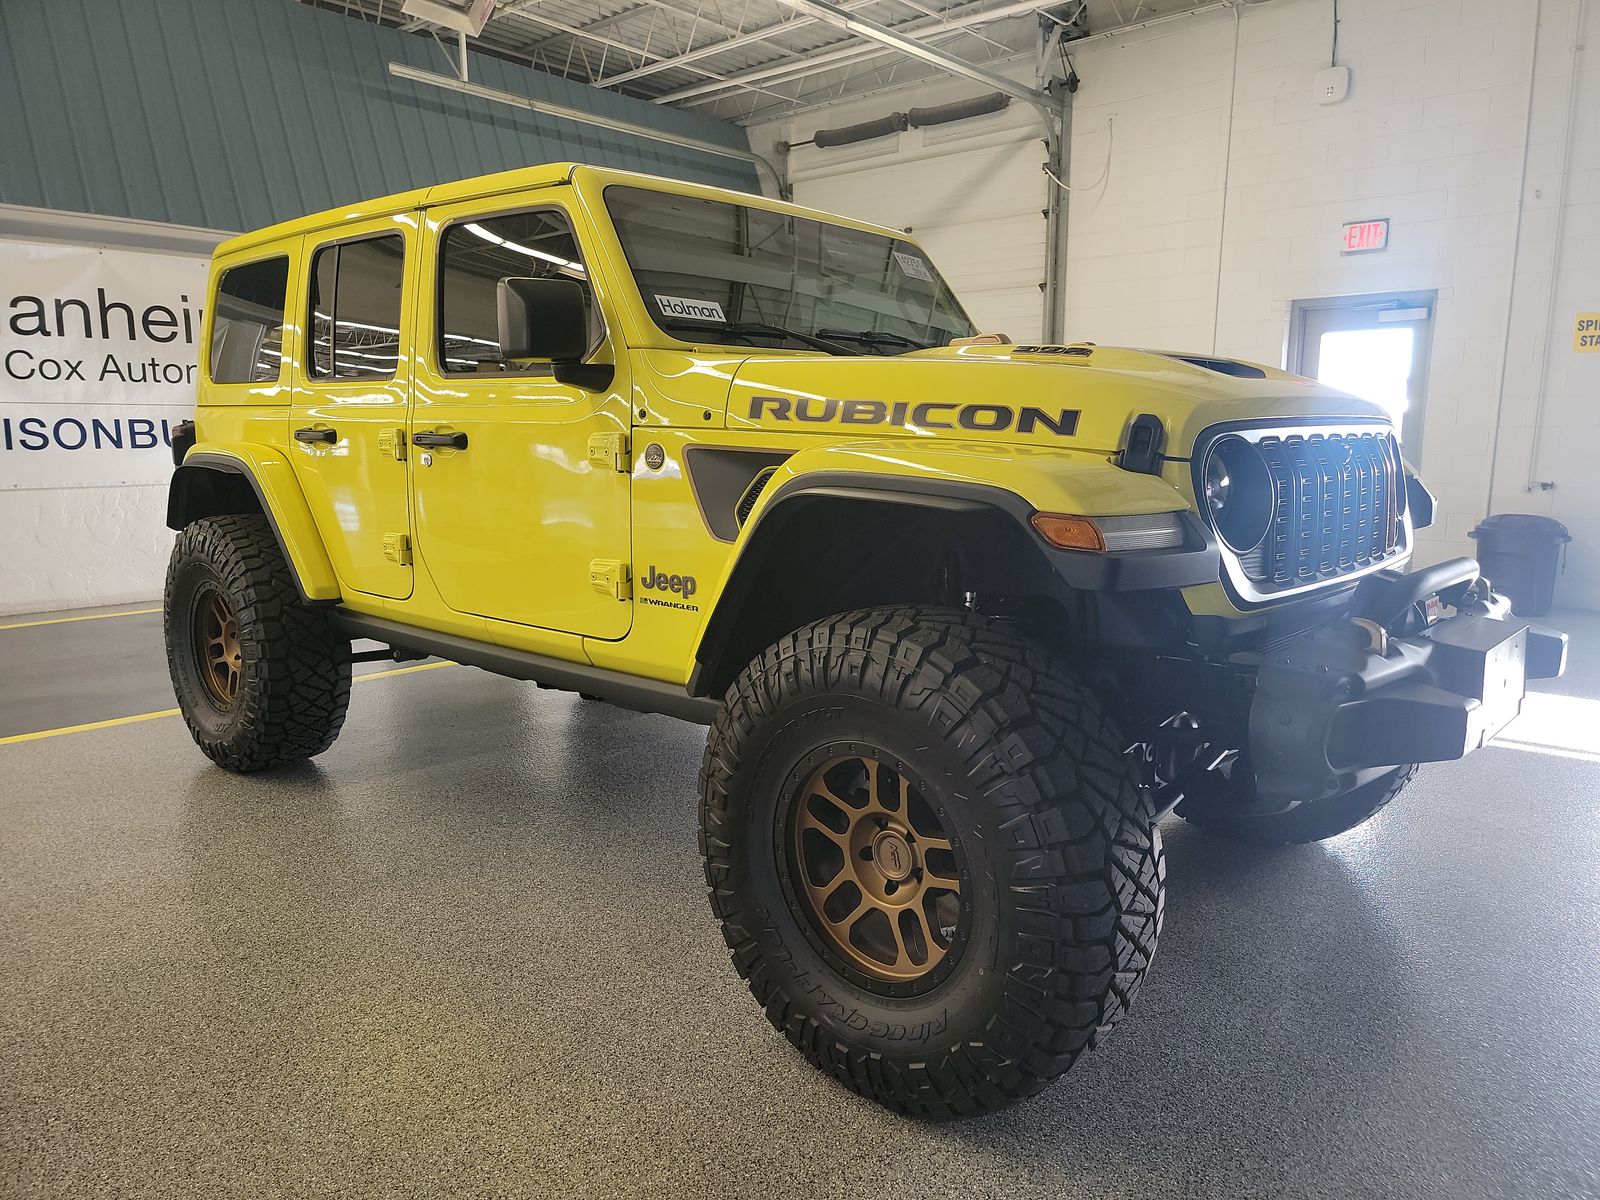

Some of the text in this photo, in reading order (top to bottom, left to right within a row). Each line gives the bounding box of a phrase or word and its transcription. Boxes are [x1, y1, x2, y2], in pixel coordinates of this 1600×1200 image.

[1347, 223, 1381, 248] EXIT
[0, 287, 203, 344] anhei
[658, 297, 723, 319] Holman
[1577, 319, 1600, 332] SPI
[4, 349, 86, 381] Cox
[748, 395, 1083, 437] RUBICON
[640, 565, 697, 600] Jeep
[648, 597, 699, 613] WRANGLER
